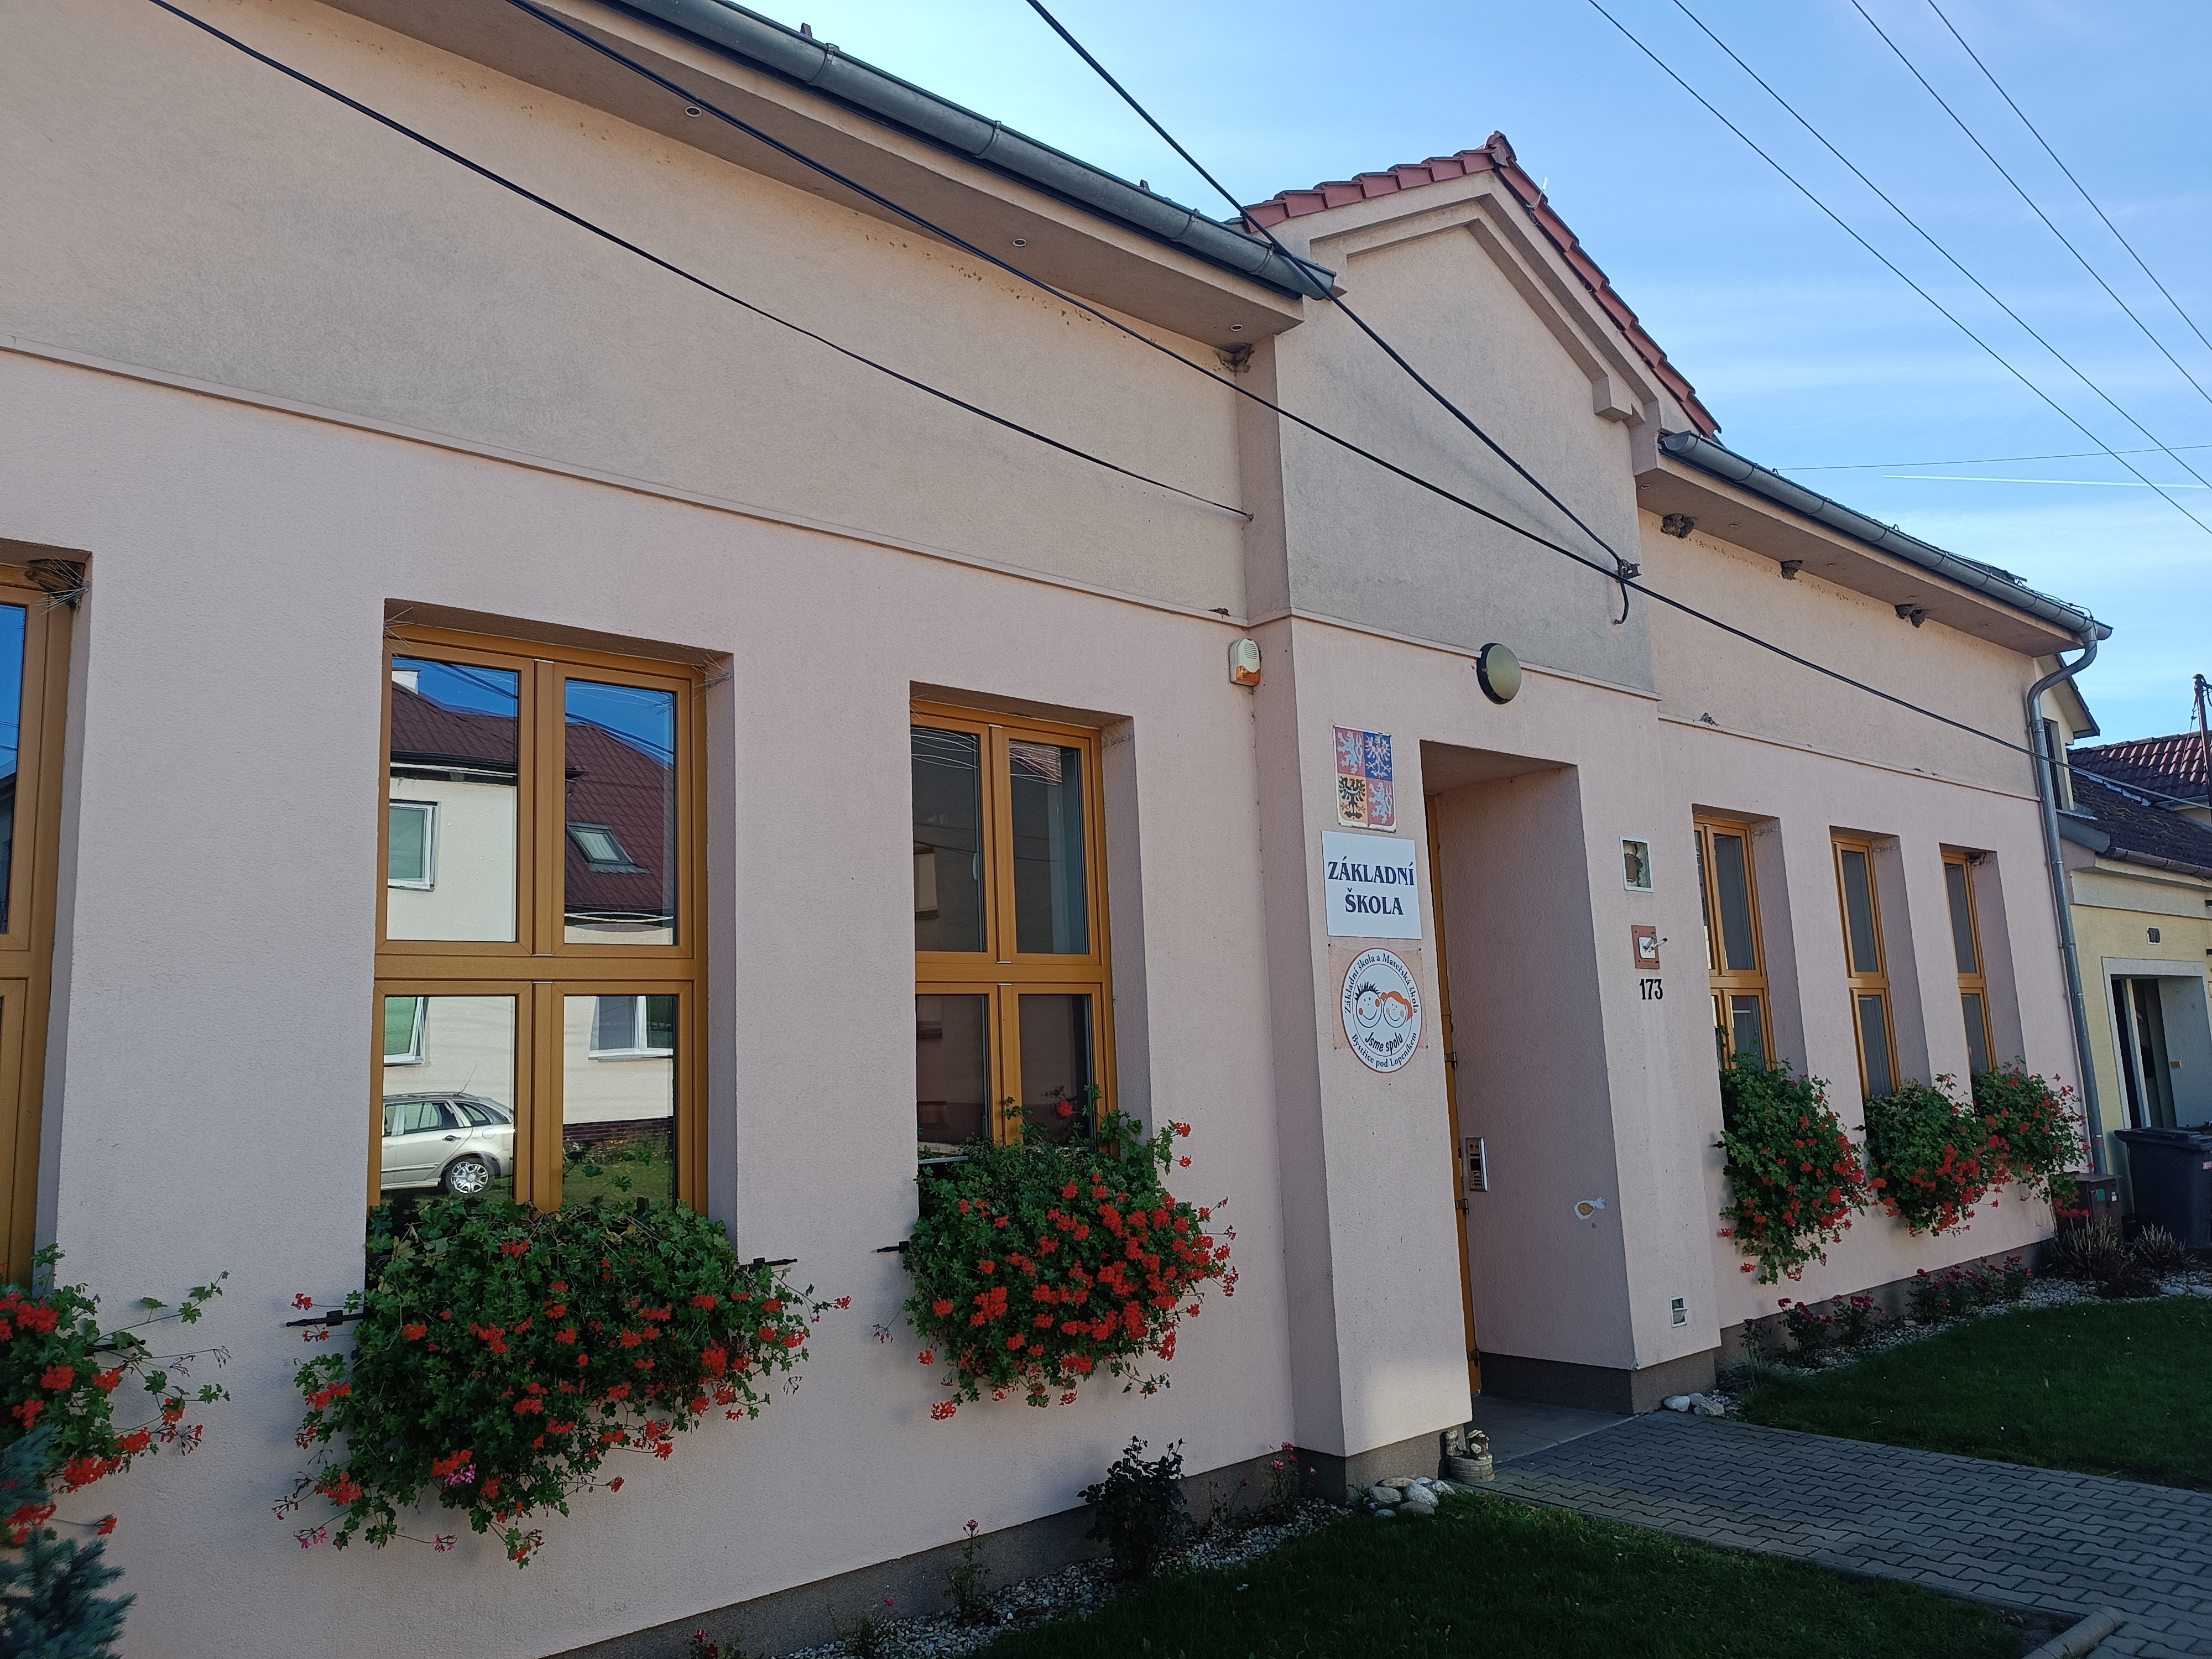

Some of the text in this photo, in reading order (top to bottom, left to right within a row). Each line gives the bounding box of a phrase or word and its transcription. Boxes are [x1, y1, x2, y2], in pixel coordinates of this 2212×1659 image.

[1328, 855, 1415, 886] ZÁKLADNÍ
[1345, 887, 1404, 915] ŠKOLA
[1344, 967, 1359, 1014] Základní
[1357, 954, 1375, 971] škola
[1382, 953, 1412, 985] Mateřská
[1408, 985, 1419, 1014] škola
[1639, 978, 1663, 1000] 173
[1352, 1033, 1374, 1063] Bystřice
[1375, 1058, 1388, 1069] pod
[1365, 1032, 1404, 1056] Jsme spolu
